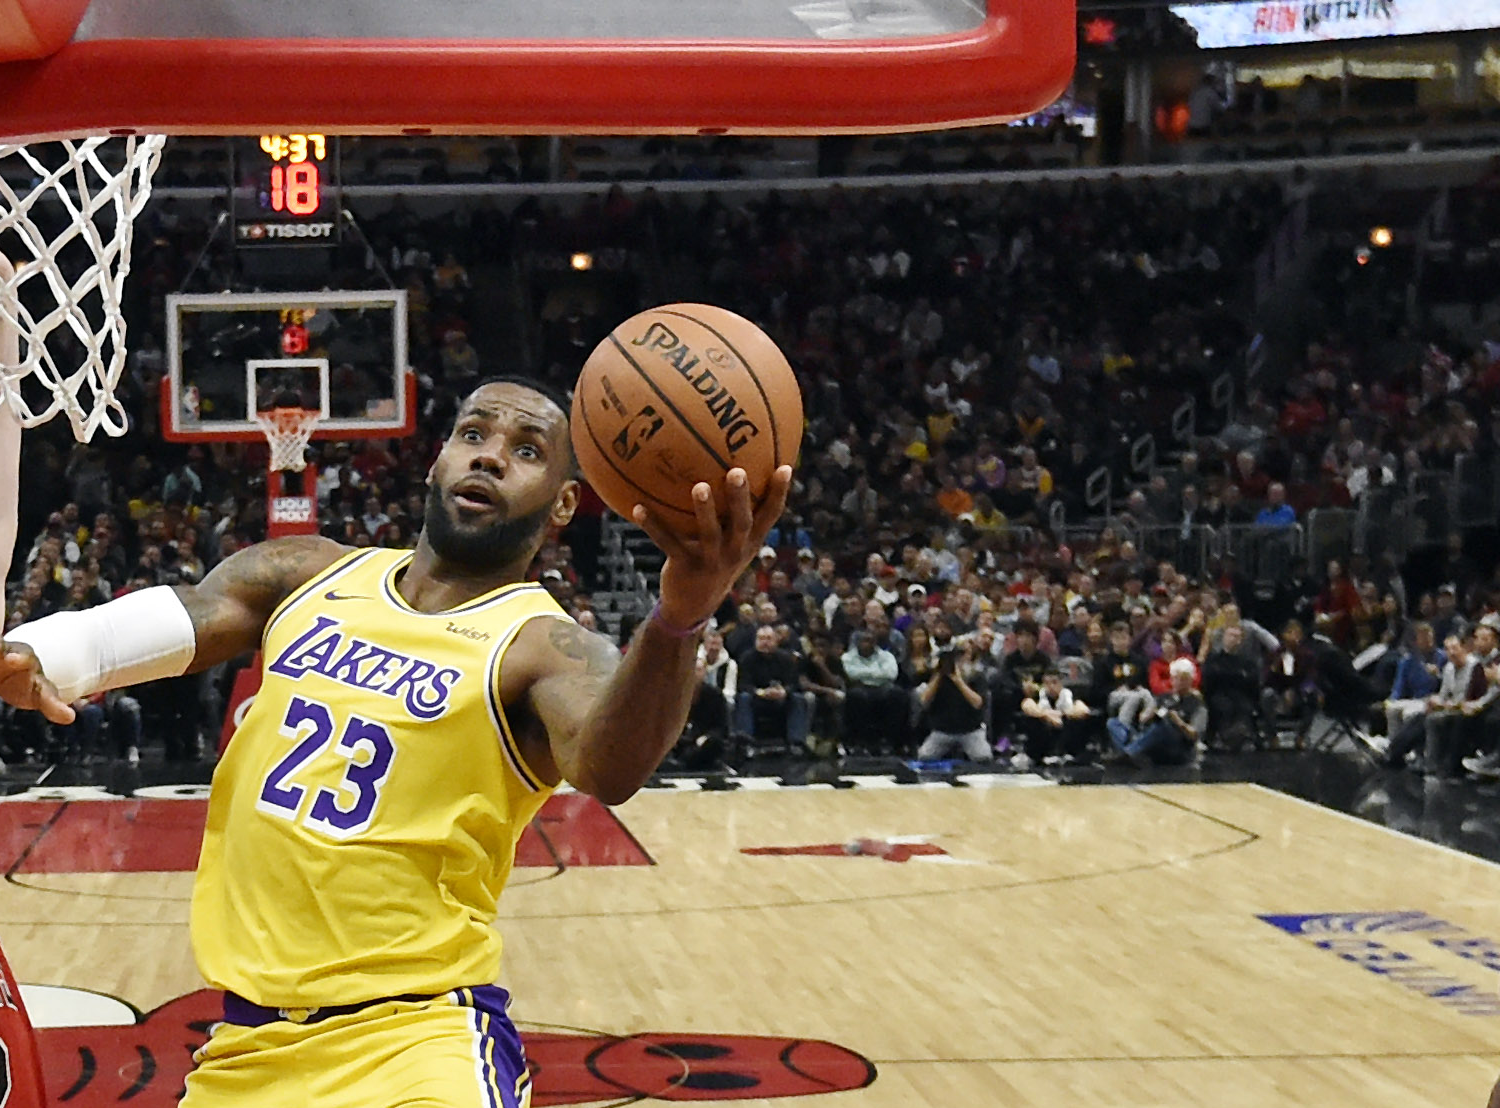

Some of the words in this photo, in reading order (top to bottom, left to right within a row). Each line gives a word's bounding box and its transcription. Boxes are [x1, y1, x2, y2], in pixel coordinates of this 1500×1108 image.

[260, 134, 326, 163] 4:37
[271, 161, 319, 215] 18
[265, 223, 335, 238] TISSOT
[631, 321, 760, 456] SPALDING
[267, 614, 463, 722] LAKERS
[256, 694, 396, 839] 23
